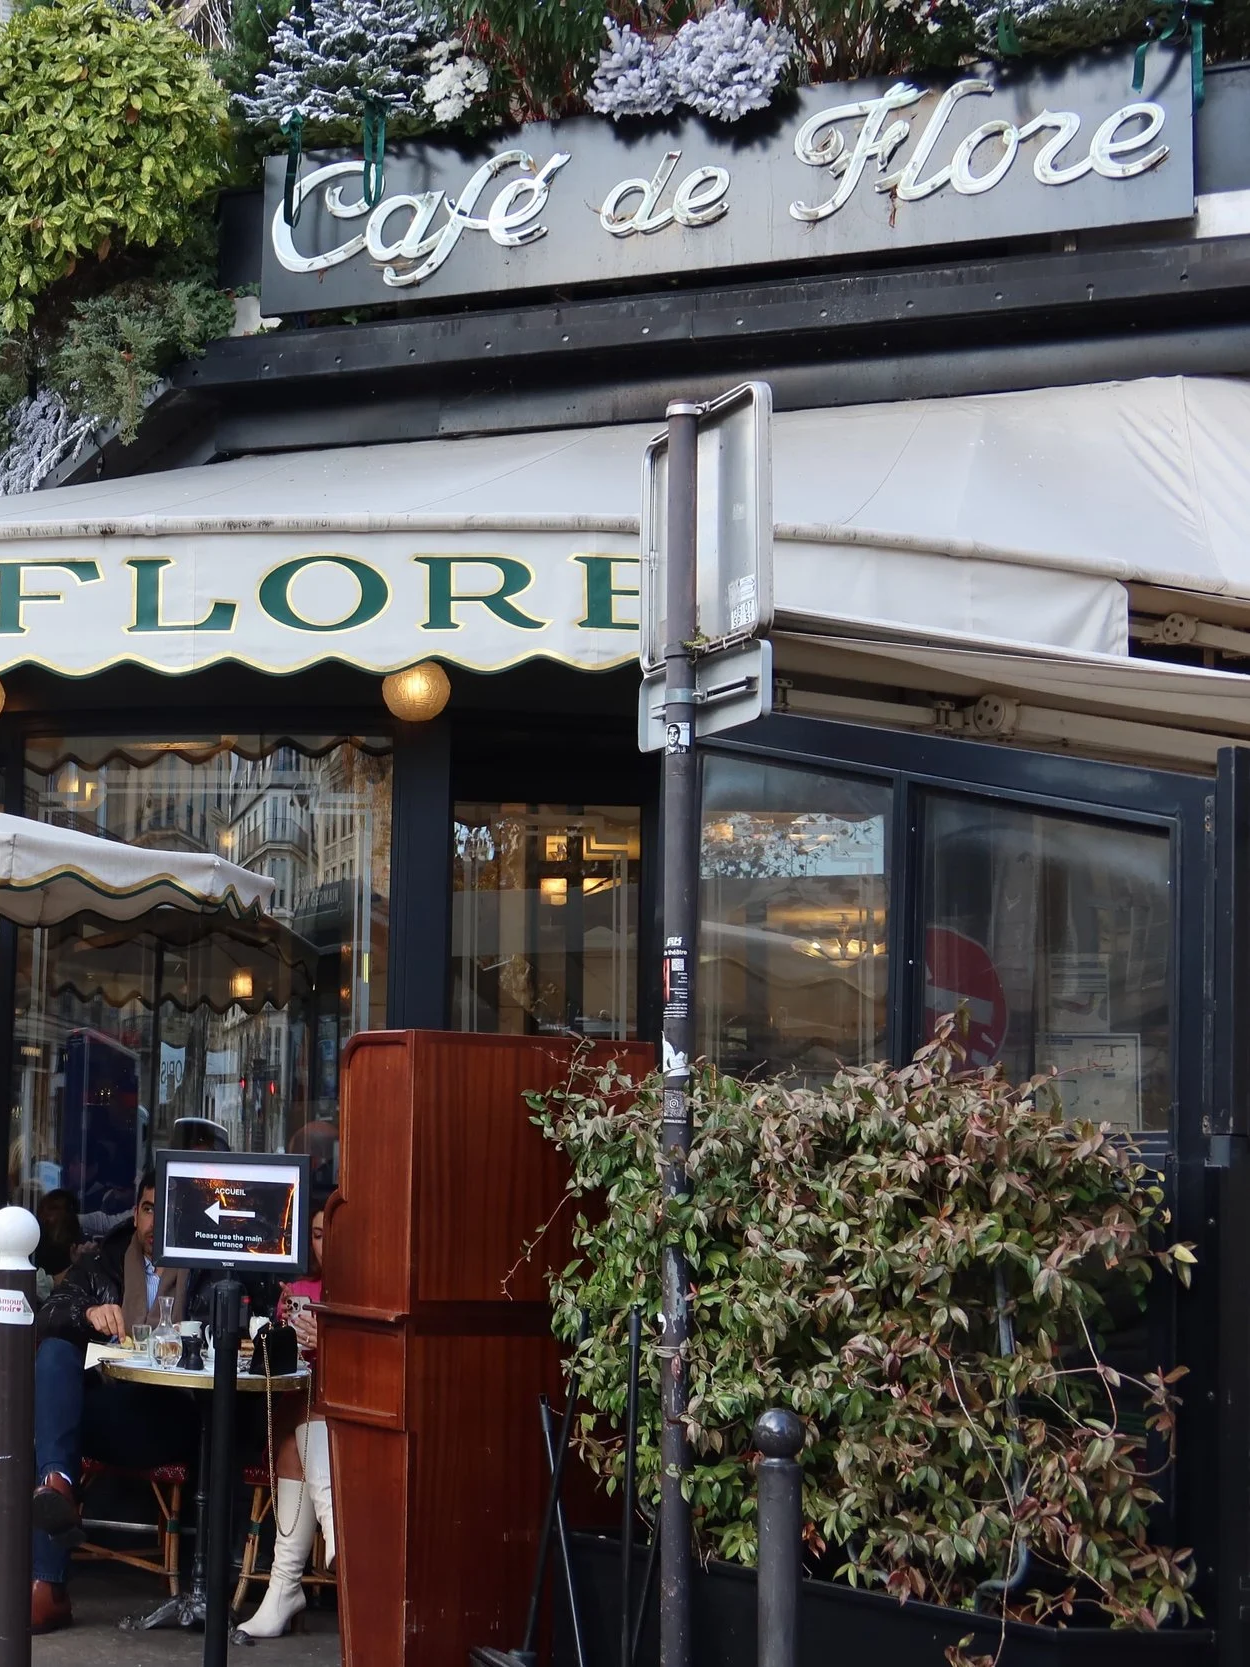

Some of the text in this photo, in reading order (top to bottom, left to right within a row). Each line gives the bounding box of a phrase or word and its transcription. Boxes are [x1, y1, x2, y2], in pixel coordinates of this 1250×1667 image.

[271, 78, 1171, 288] Café de Flore
[214, 1187, 246, 1196] ACCUEIL
[195, 1231, 218, 1240] Please
[232, 1233, 244, 1241] the
[245, 1235, 263, 1243] main
[213, 1241, 244, 1249] entrance
